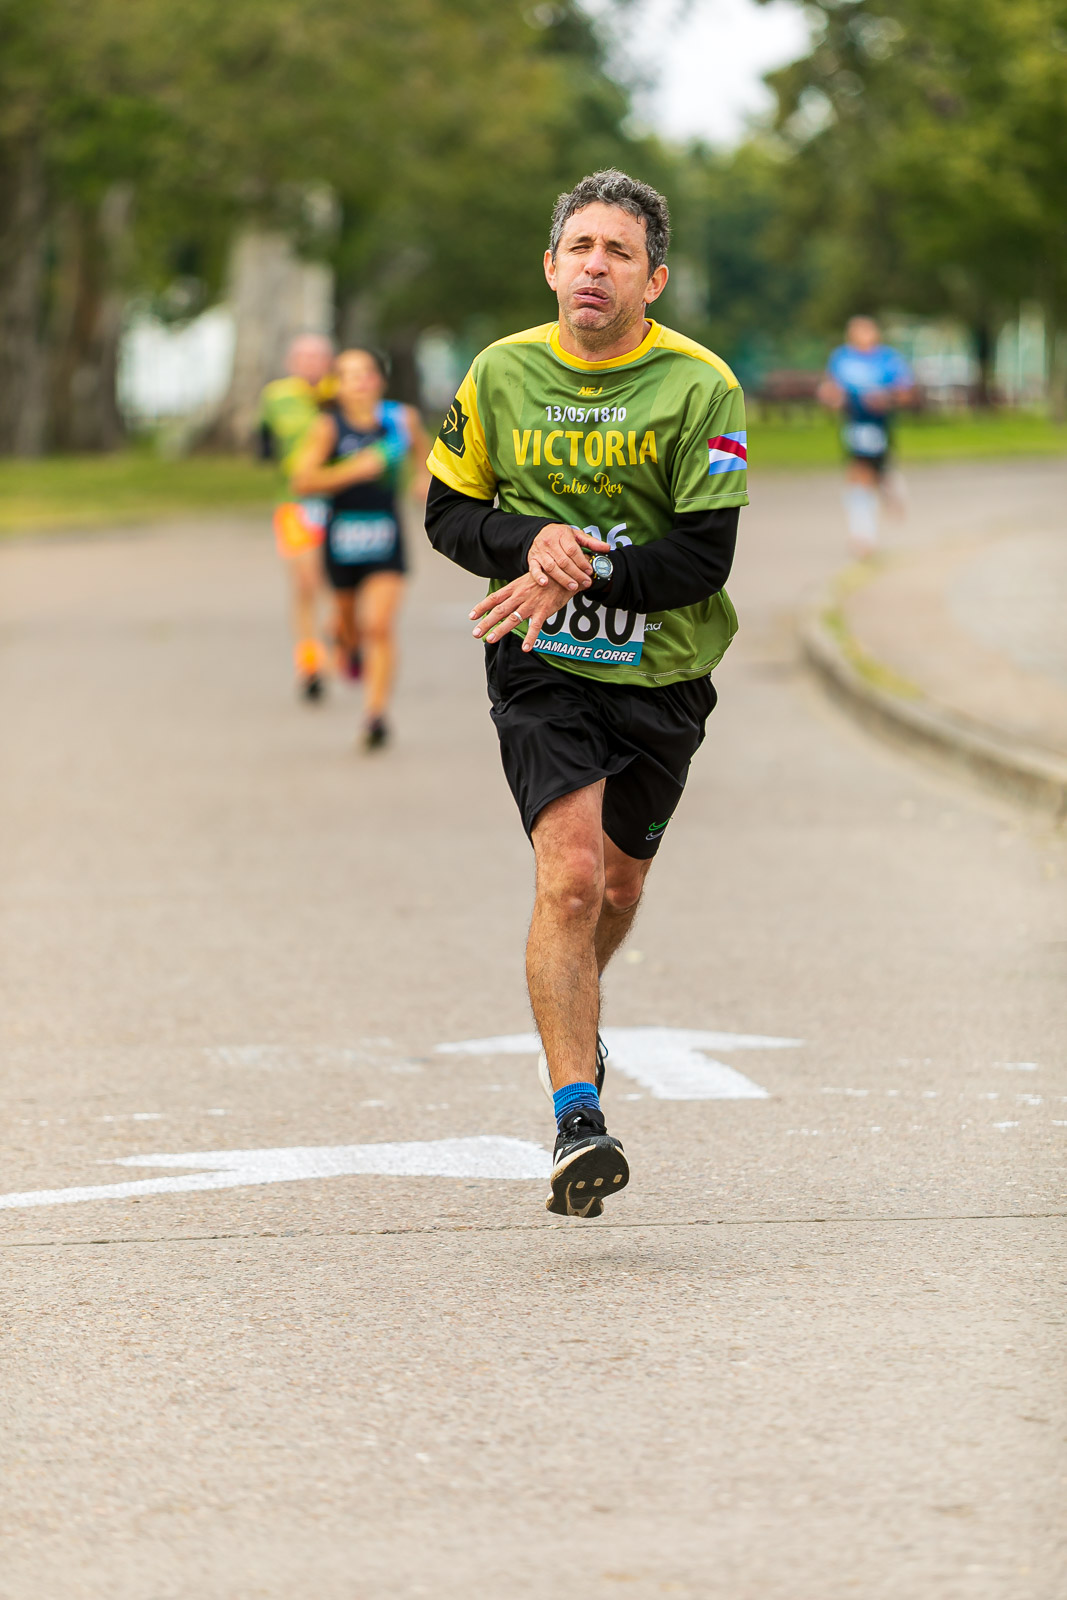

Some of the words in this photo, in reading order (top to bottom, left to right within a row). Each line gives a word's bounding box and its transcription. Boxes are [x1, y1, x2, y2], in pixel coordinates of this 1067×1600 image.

[545, 406, 627, 423] 13/05/1810
[512, 430, 658, 467] VICTORIA
[548, 472, 590, 495] Entre
[533, 638, 593, 658] DIAMANTE
[593, 649, 636, 662] CORRE
